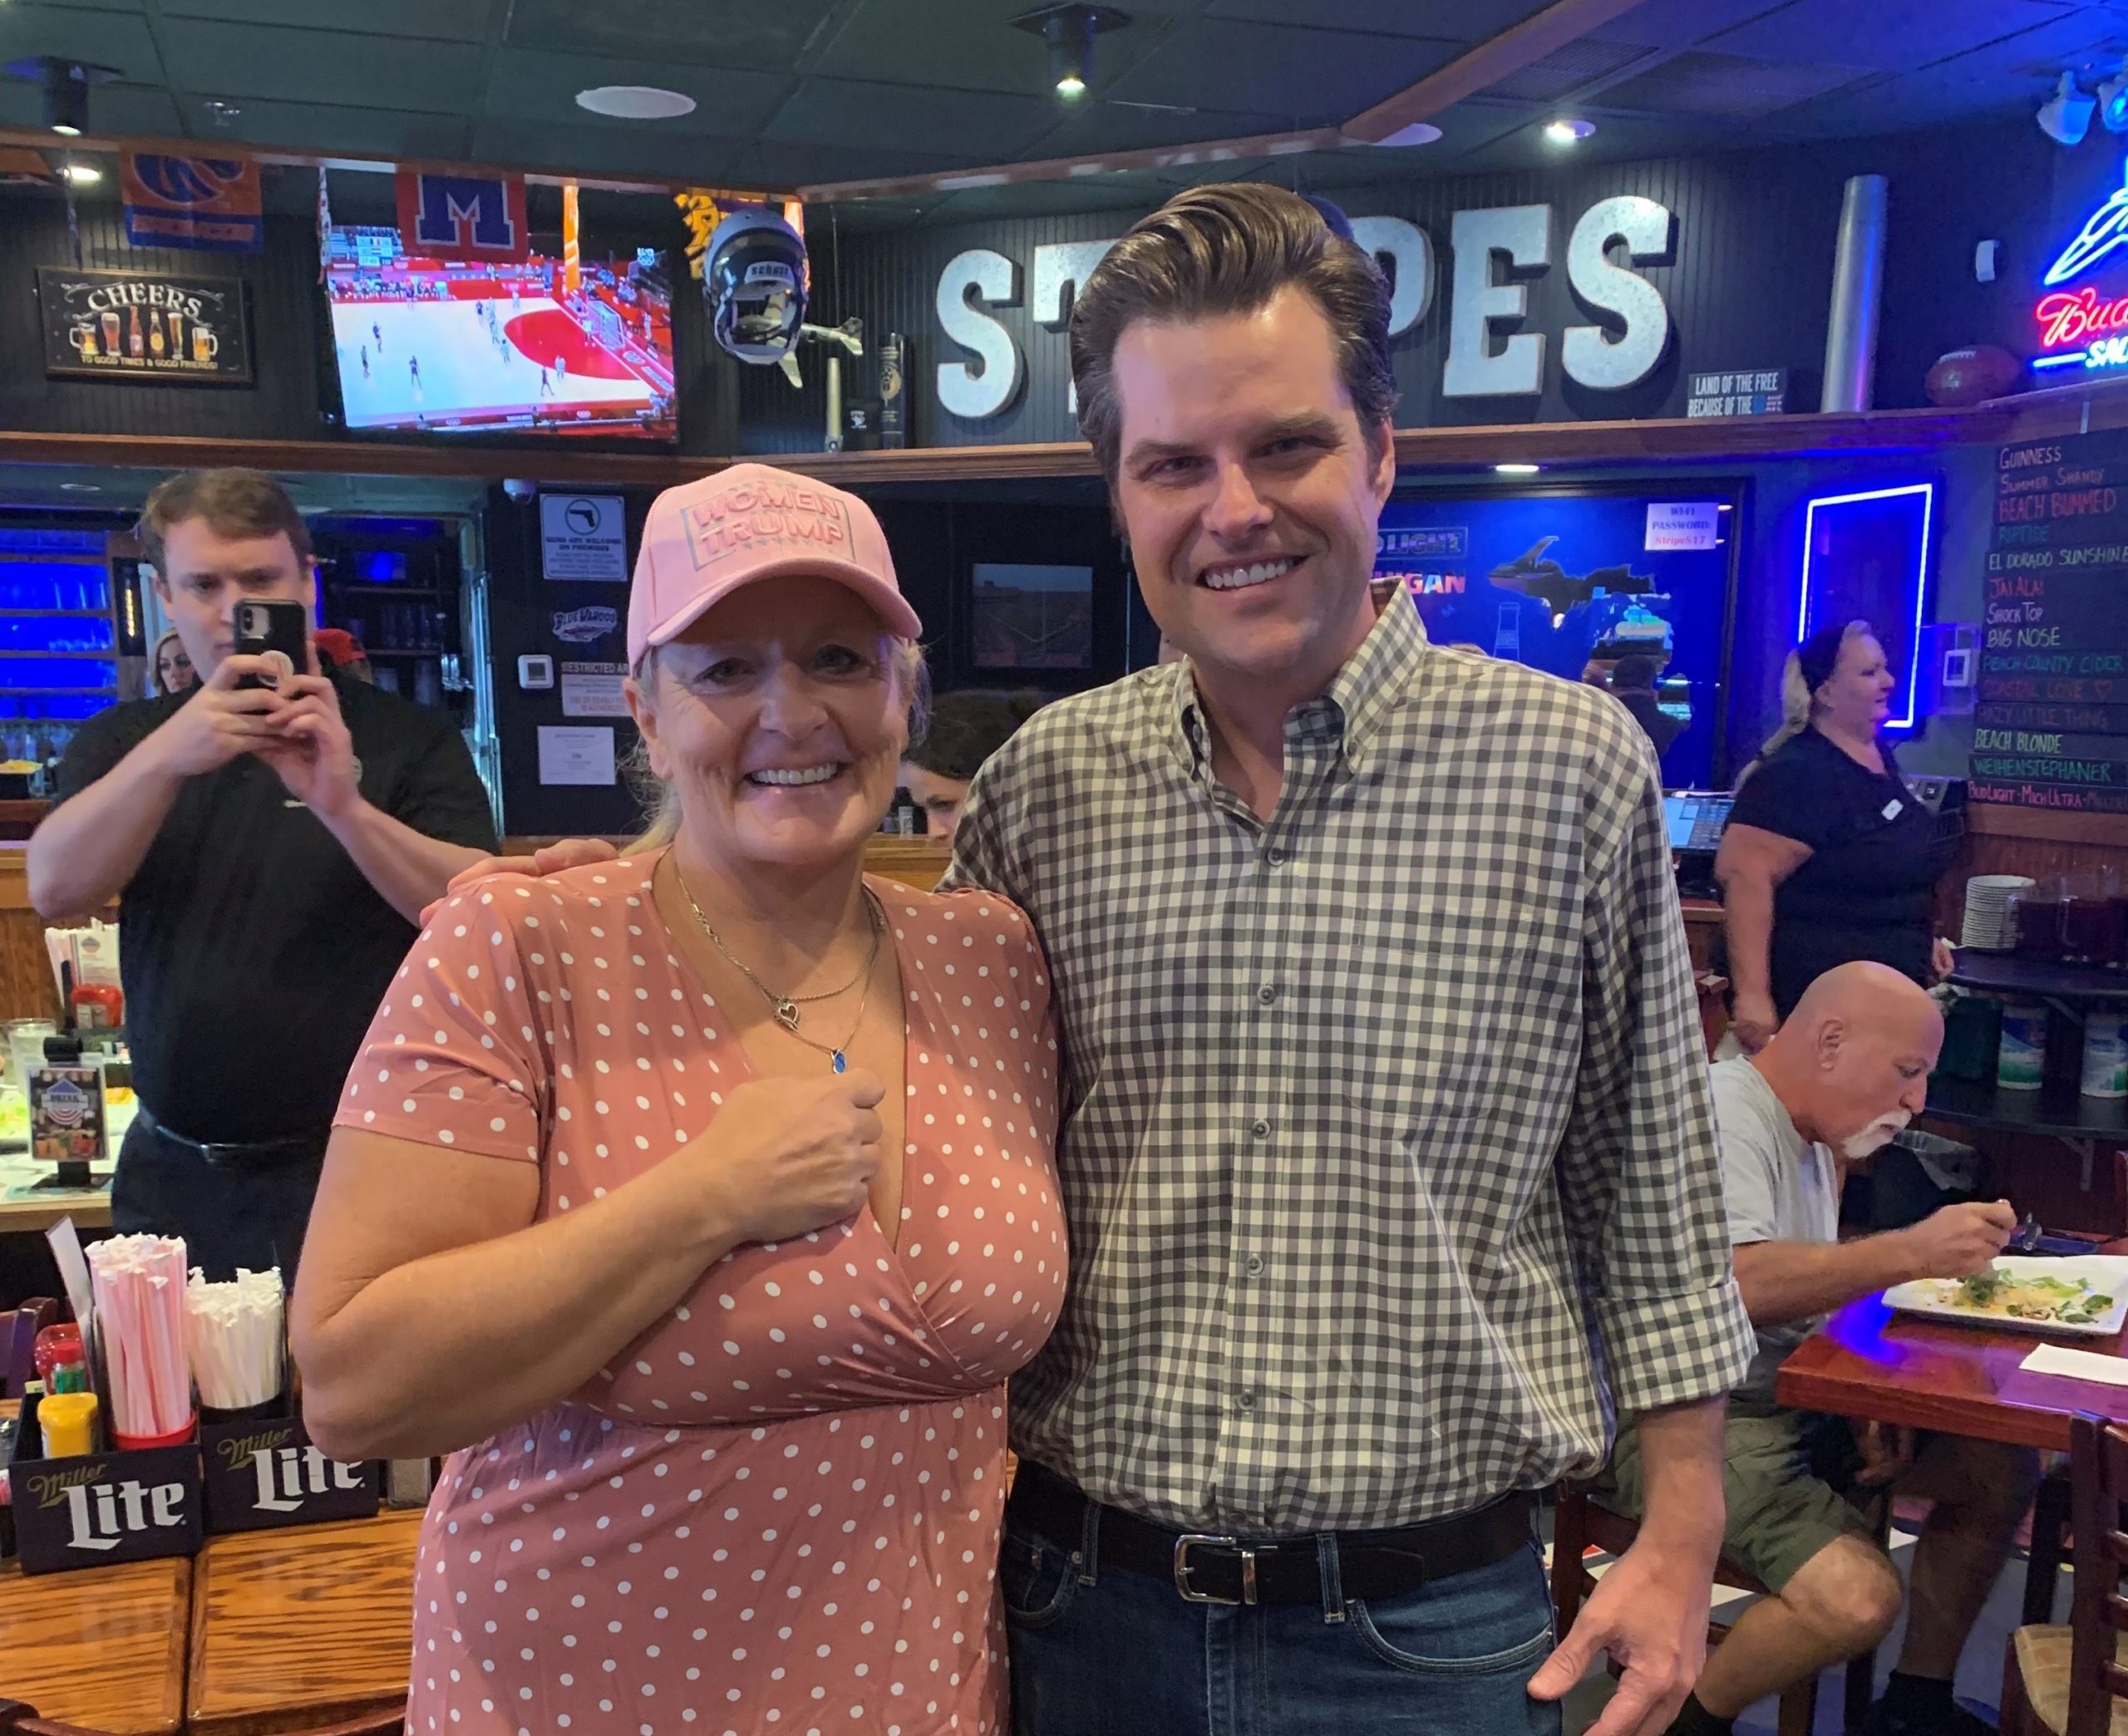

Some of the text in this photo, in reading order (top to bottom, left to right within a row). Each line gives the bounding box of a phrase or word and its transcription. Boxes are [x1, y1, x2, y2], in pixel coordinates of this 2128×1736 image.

[87, 283, 202, 317] CHEERS
[94, 356, 118, 365] GOOD
[121, 357, 145, 366] TIMES
[155, 359, 179, 367] GOOD
[1696, 372, 1778, 395] LAND OF THE FREE
[1687, 397, 1724, 417] BECAUSE
[1724, 396, 1736, 416] OF
[1736, 396, 1753, 415] THE
[1999, 445, 2062, 470] GUINNESS
[692, 486, 840, 528] WOMEN
[1999, 494, 2046, 523] BEACH
[700, 513, 845, 555] TRUMP
[1989, 553, 2002, 570] EL
[2007, 551, 2053, 569] DORADO
[1986, 627, 2061, 648] BIG NOSE
[1974, 728, 2064, 754] BEACH BLONDE
[218, 1428, 293, 1470] Miller
[27, 1463, 185, 1551] Miller Lite
